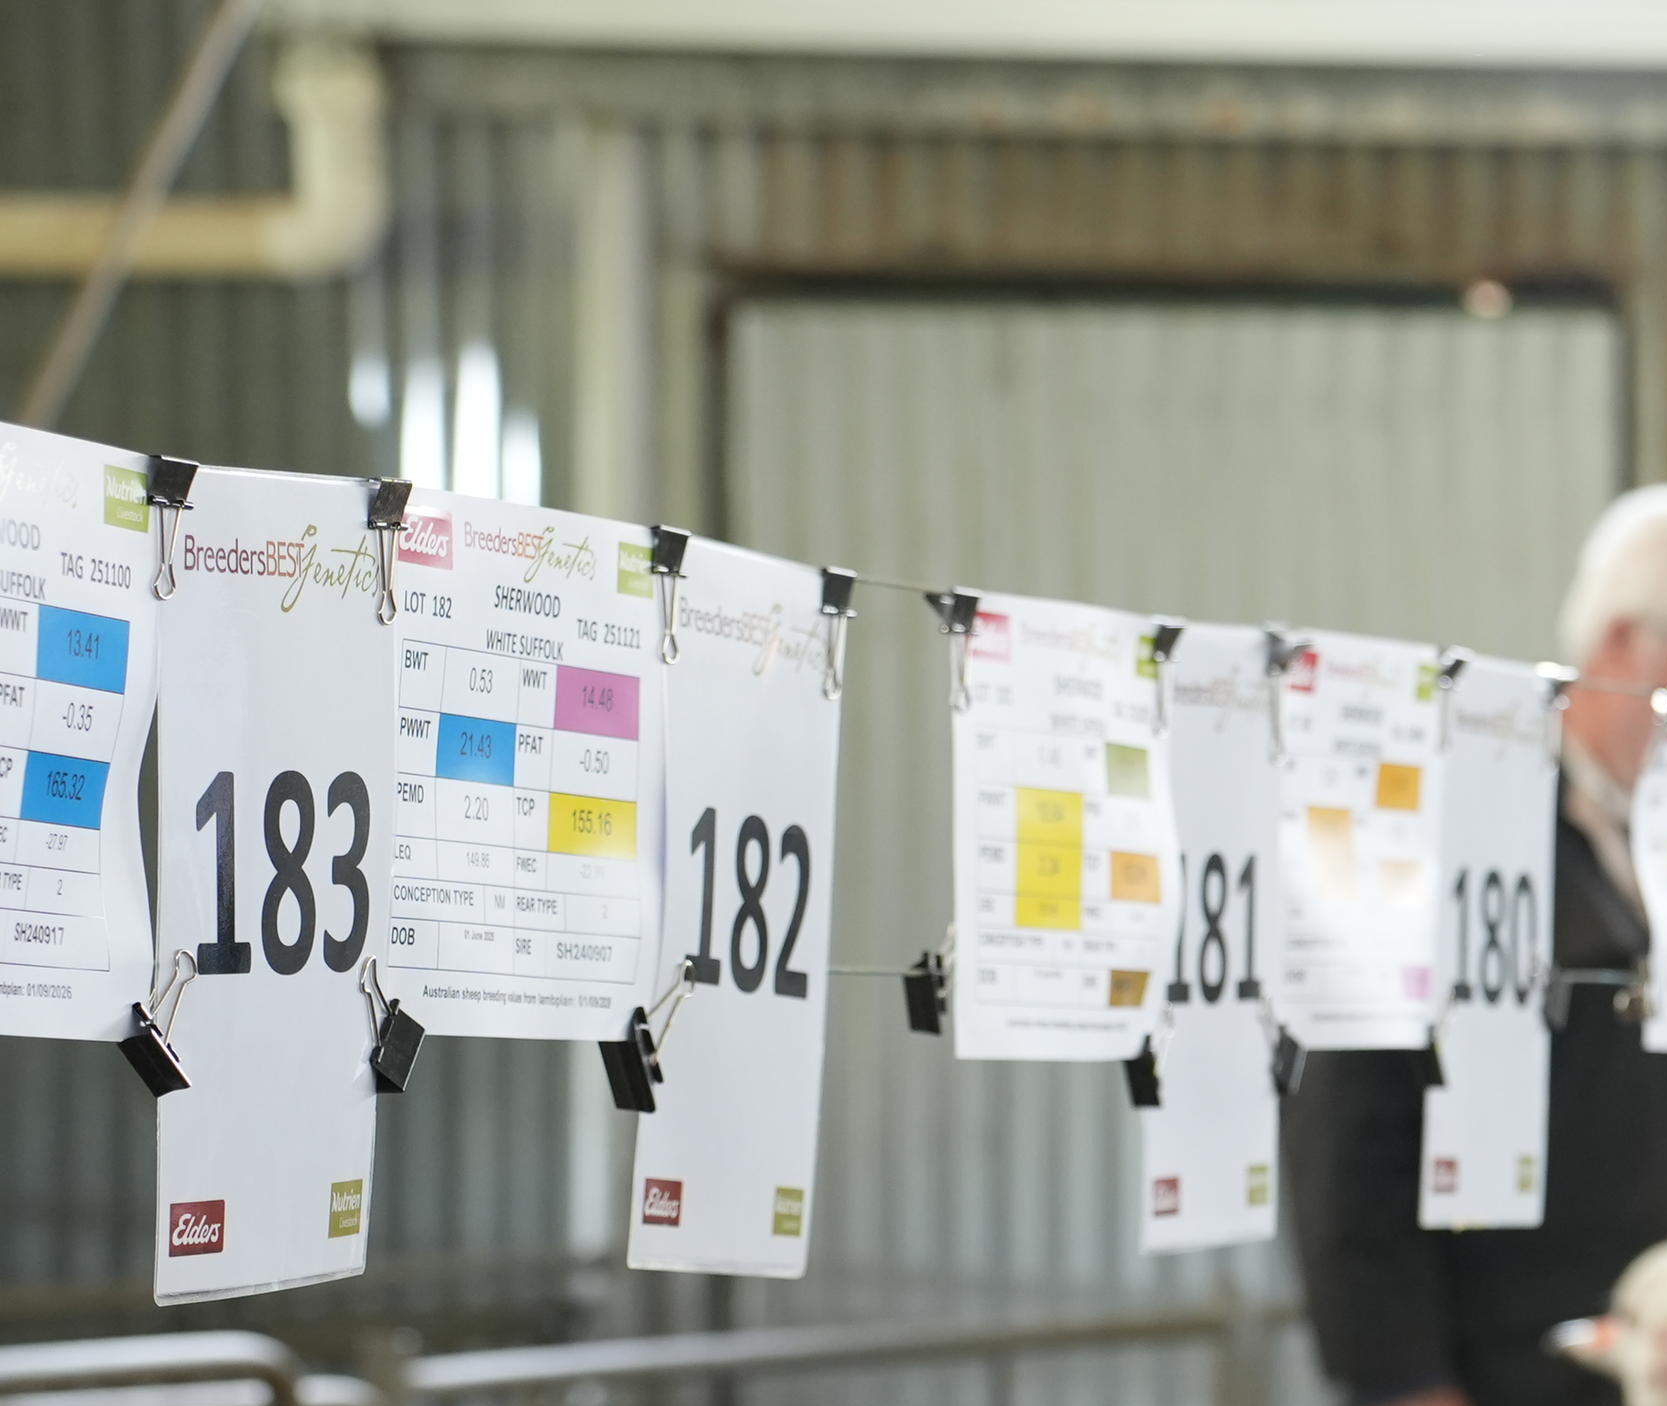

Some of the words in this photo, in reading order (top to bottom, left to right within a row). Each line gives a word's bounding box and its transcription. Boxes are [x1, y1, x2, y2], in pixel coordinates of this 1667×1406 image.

[399, 515, 450, 558] Elders
[61, 552, 83, 579] TAG
[90, 558, 131, 589] 251100
[404, 590, 426, 615] LOT
[432, 593, 452, 619] 182
[494, 585, 561, 618] SHERWOOD
[67, 629, 100, 659] 13.41
[486, 630, 518, 653] WHITE
[519, 634, 565, 662] SUFFOLK
[577, 618, 597, 642] TAG
[603, 623, 641, 649] 251121
[404, 650, 429, 672] BWT
[469, 667, 493, 694] 0.53
[522, 669, 548, 690] WWT
[582, 686, 613, 712] 14.48
[62, 702, 93, 731] -0.35
[400, 717, 431, 739] PWWT
[459, 732, 492, 758] 21.43
[518, 734, 543, 754] PFAT
[46, 771, 86, 800] 165.32
[398, 782, 424, 804] PEMD
[464, 796, 489, 821] 2.20
[516, 797, 535, 817] TCP
[571, 810, 613, 836] 155.16
[195, 770, 371, 975] 183
[516, 856, 537, 873] FWEC
[57, 879, 63, 895] 2
[393, 884, 451, 905] CONCEPTION
[453, 890, 474, 907] TYPE
[516, 895, 535, 912] REAR
[537, 898, 558, 915] TYPE
[685, 806, 811, 1000] 182
[14, 922, 65, 946] SH240917
[391, 927, 416, 946] DOB
[515, 938, 532, 955] SIRE
[1167, 853, 1260, 1003] 181
[1453, 869, 1538, 1003] 180
[422, 984, 460, 1000] Australian
[462, 986, 481, 1003] sheep
[331, 1189, 361, 1213] Nutrien
[172, 1213, 222, 1246] Elders
